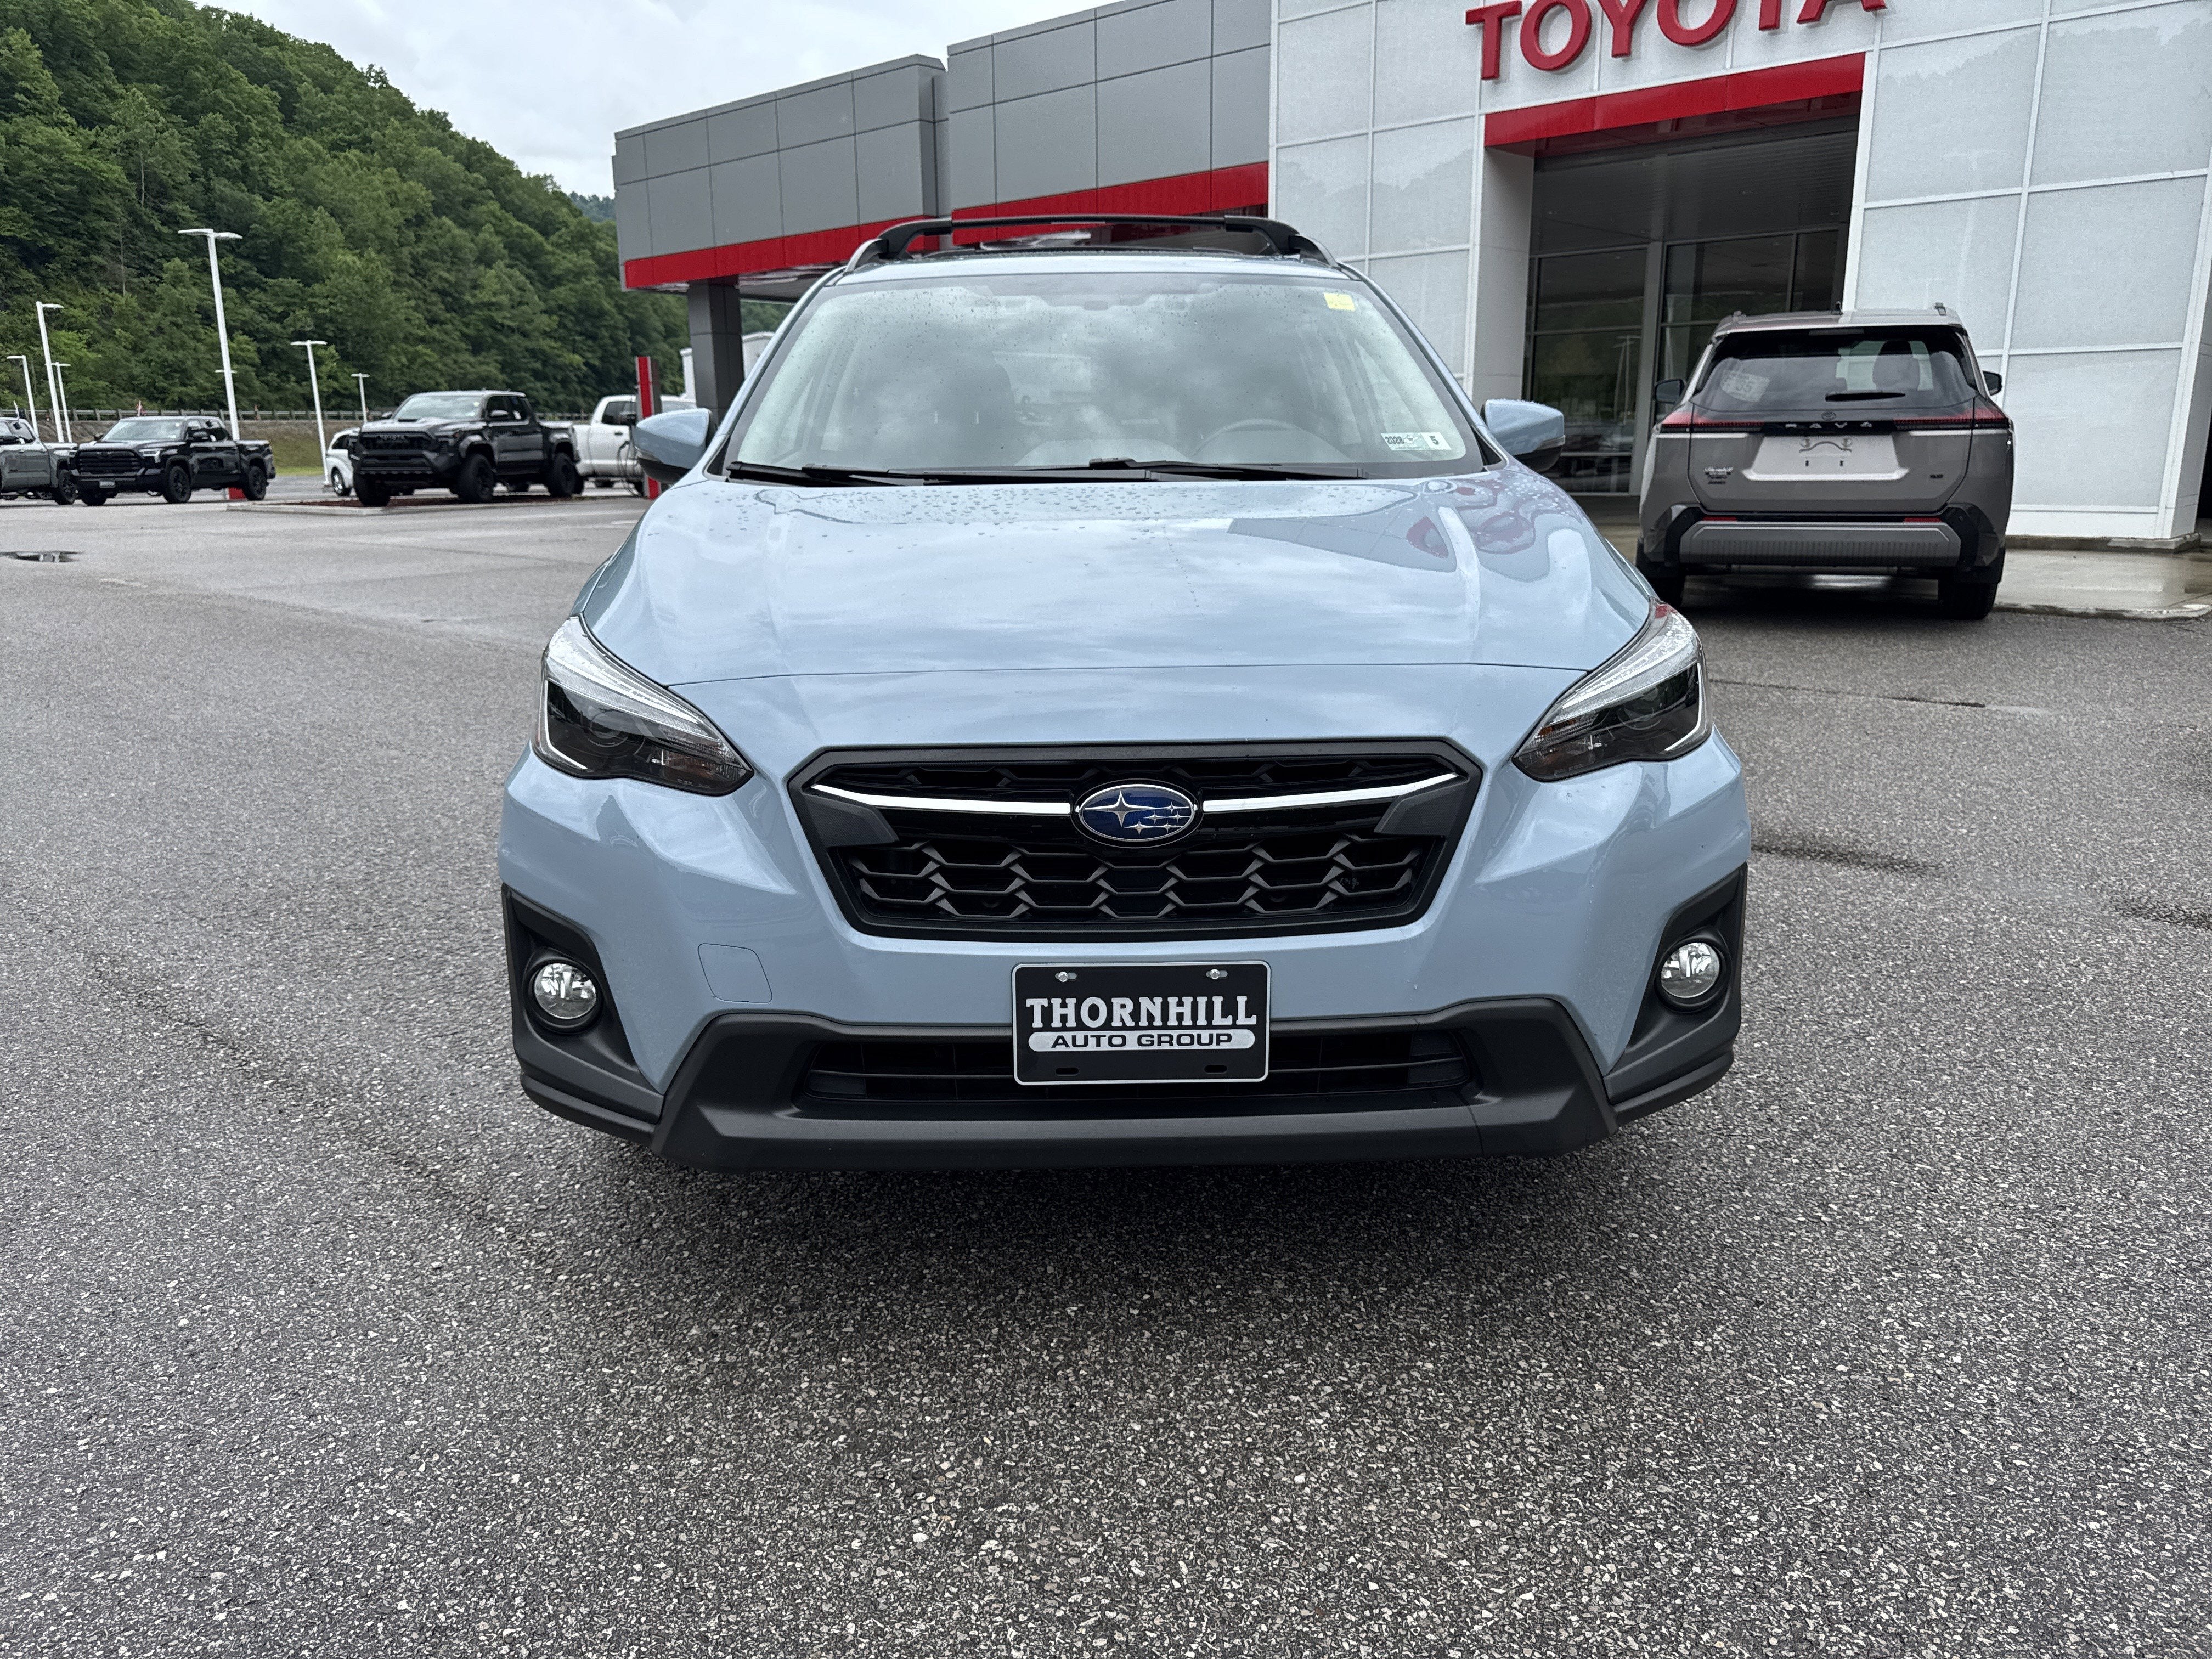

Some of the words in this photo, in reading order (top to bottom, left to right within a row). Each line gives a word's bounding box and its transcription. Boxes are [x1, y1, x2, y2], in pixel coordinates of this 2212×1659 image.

[1466, 0, 1887, 80] TOYO
[1429, 436, 1439, 445] 5
[1026, 996, 1257, 1028] THORNHILL
[1051, 1034, 1127, 1048] AUTO
[1137, 1032, 1232, 1047] GROUP
